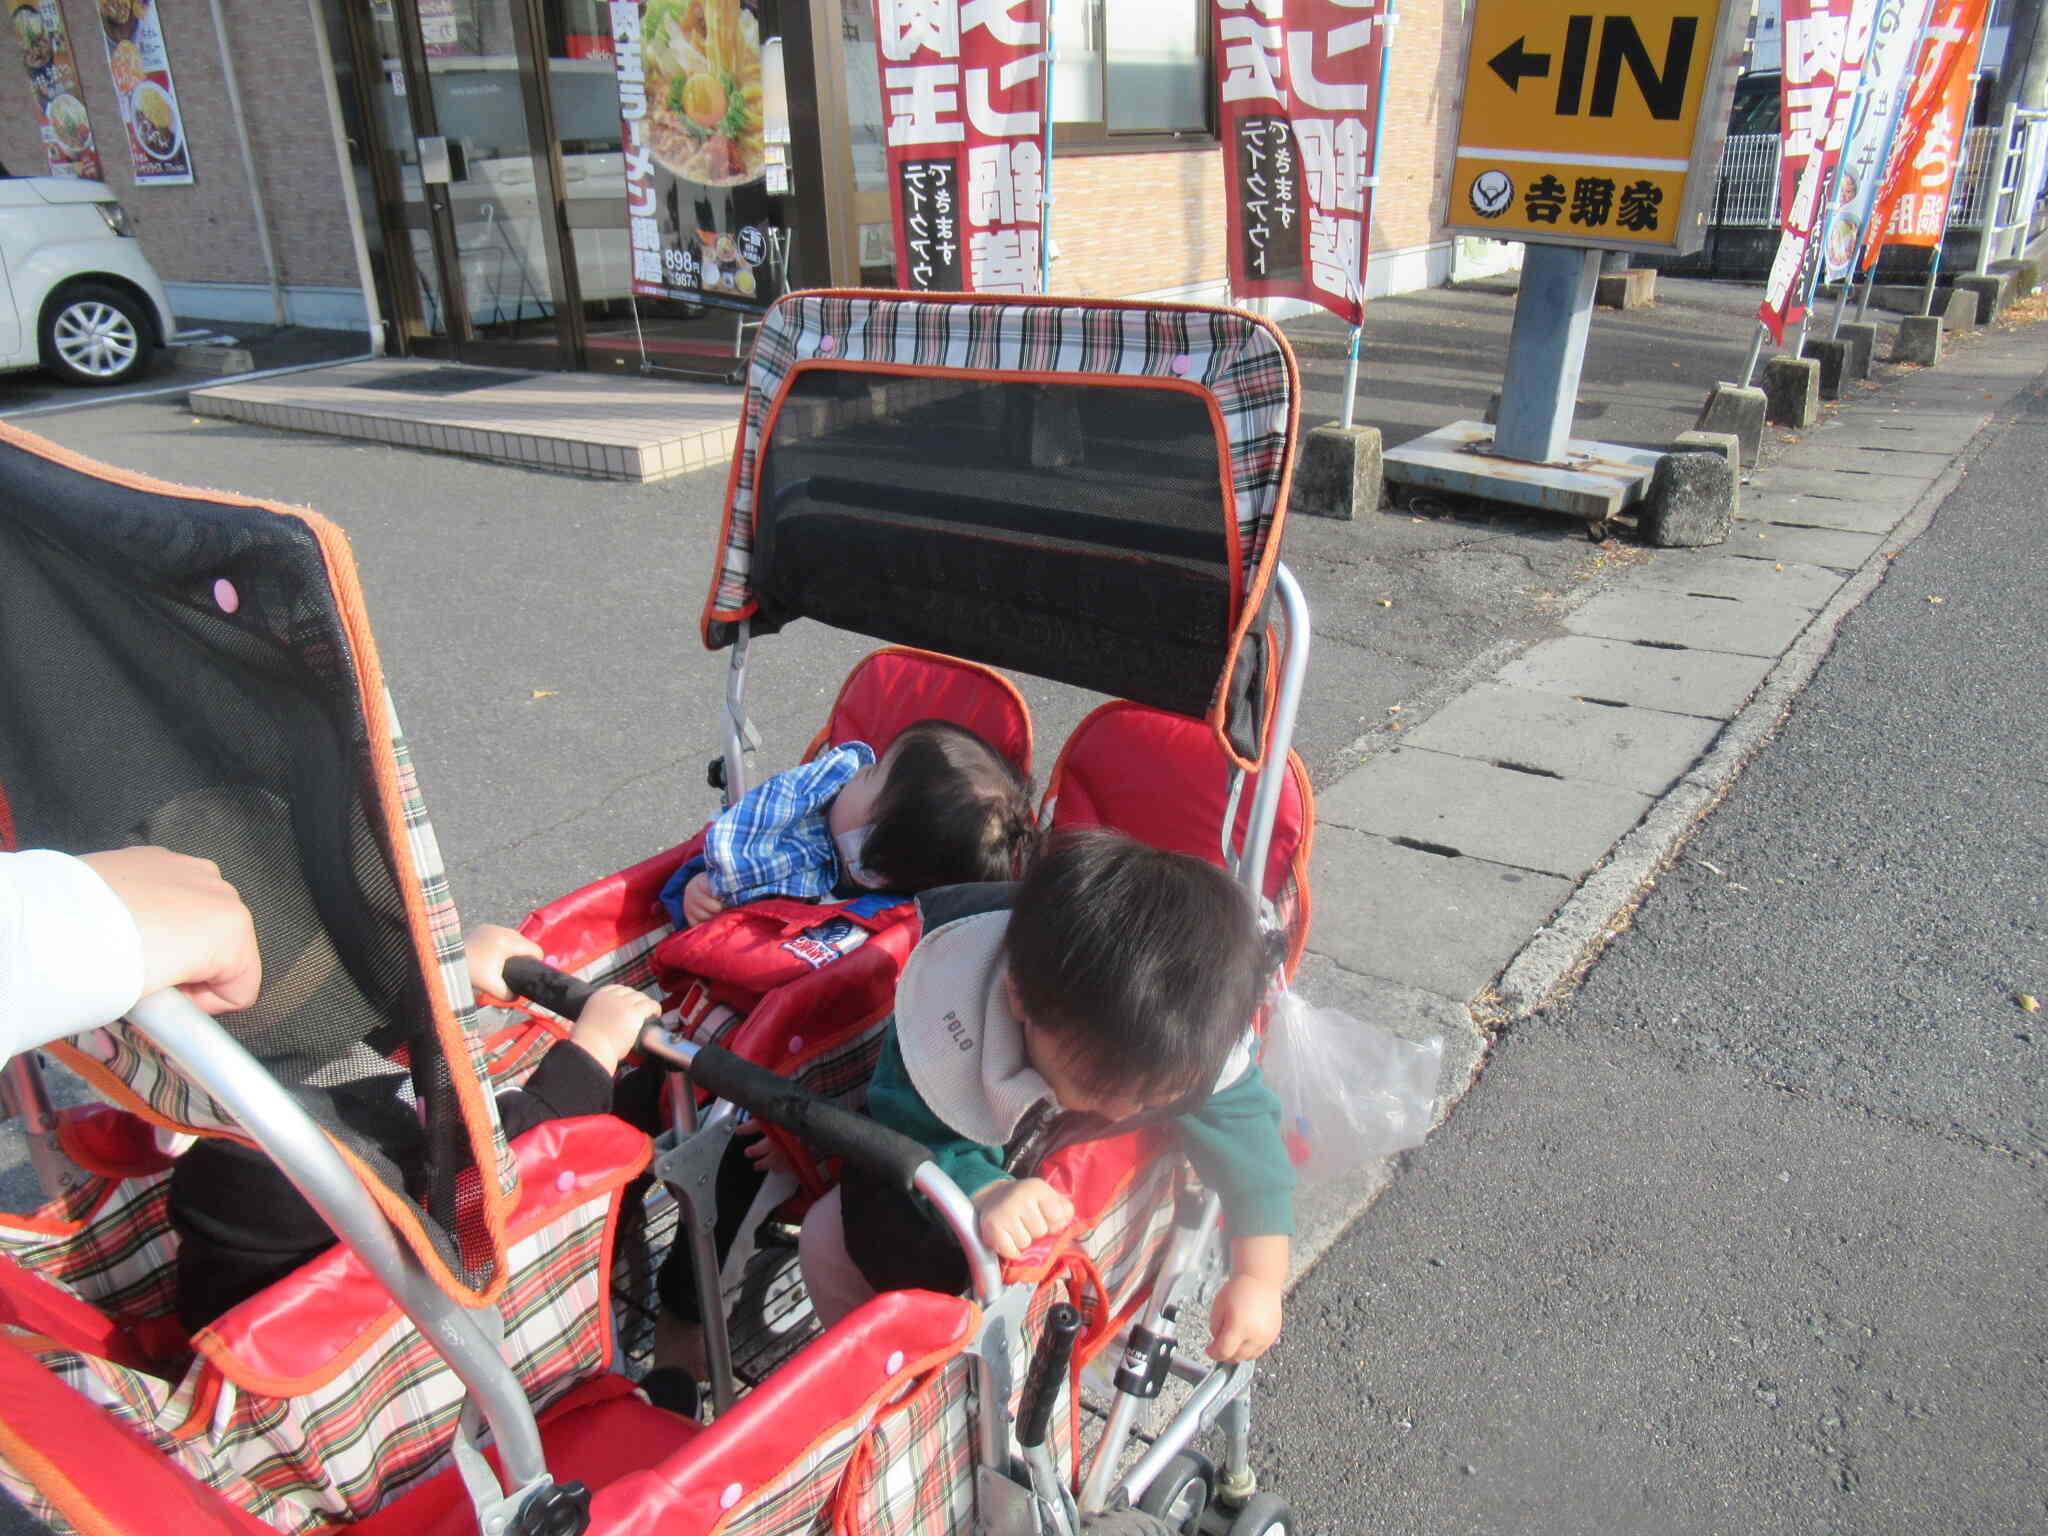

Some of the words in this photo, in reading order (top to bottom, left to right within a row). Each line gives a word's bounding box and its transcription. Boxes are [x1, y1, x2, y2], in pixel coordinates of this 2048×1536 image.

[1555, 14, 1698, 121] IN
[1524, 173, 1664, 232] 吉野家
[942, 1010, 974, 1053] POLO
